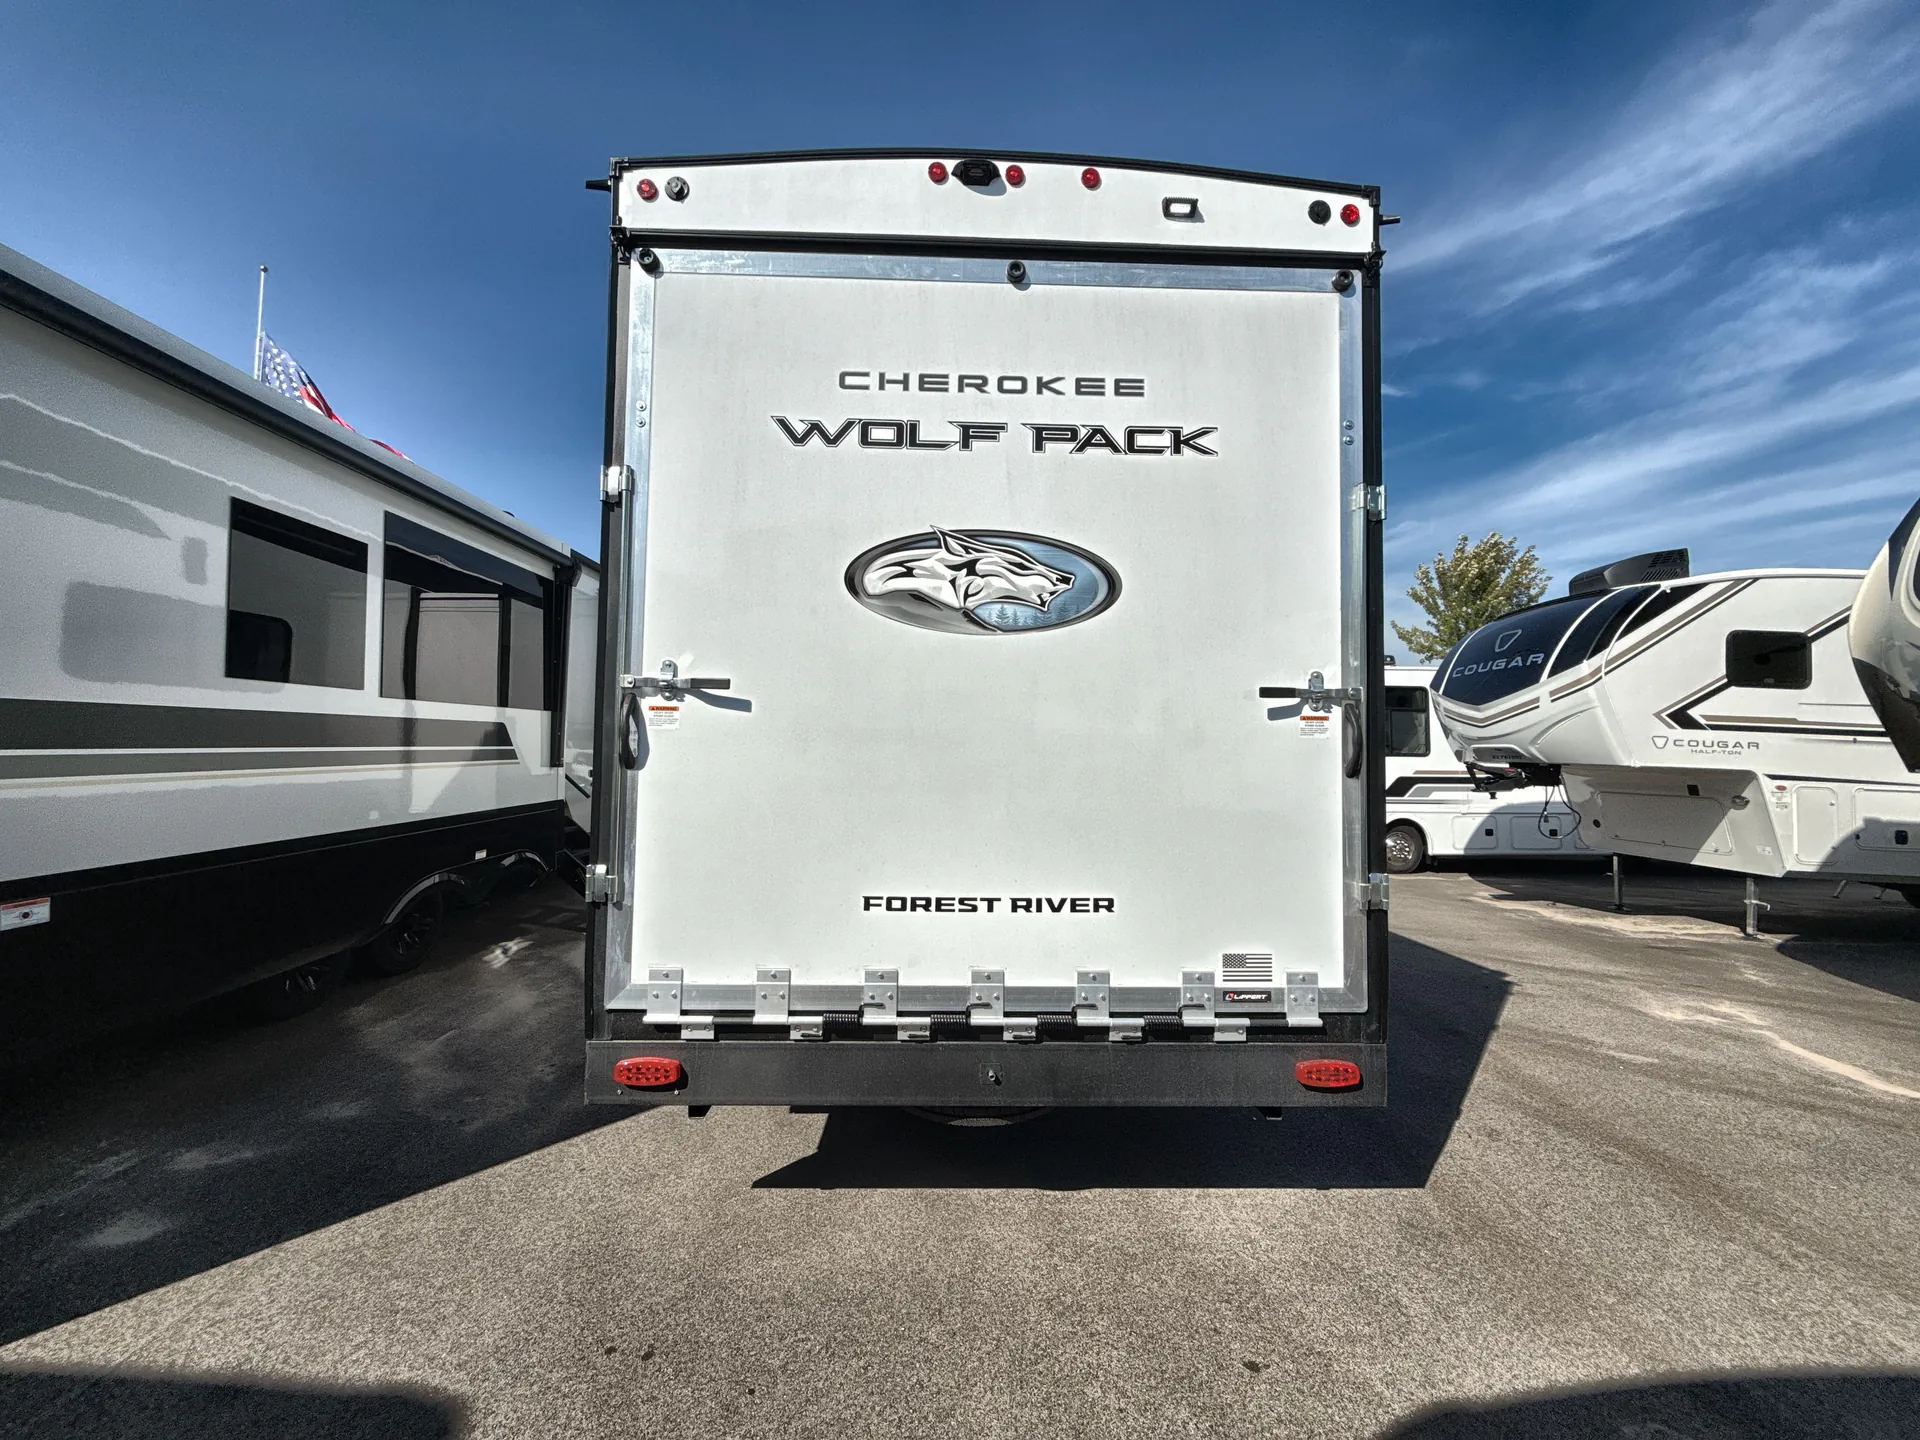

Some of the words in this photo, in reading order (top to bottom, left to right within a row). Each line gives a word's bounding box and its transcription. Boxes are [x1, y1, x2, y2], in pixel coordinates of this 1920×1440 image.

[839, 371, 1146, 398] CHEROKEE
[771, 415, 1009, 452] WOLF
[1021, 423, 1219, 457] PACK
[1452, 653, 1545, 678] COUGAR
[1673, 739, 1760, 750] COUGAR
[862, 896, 1002, 913] FOREST
[1009, 897, 1115, 914] RIVER
